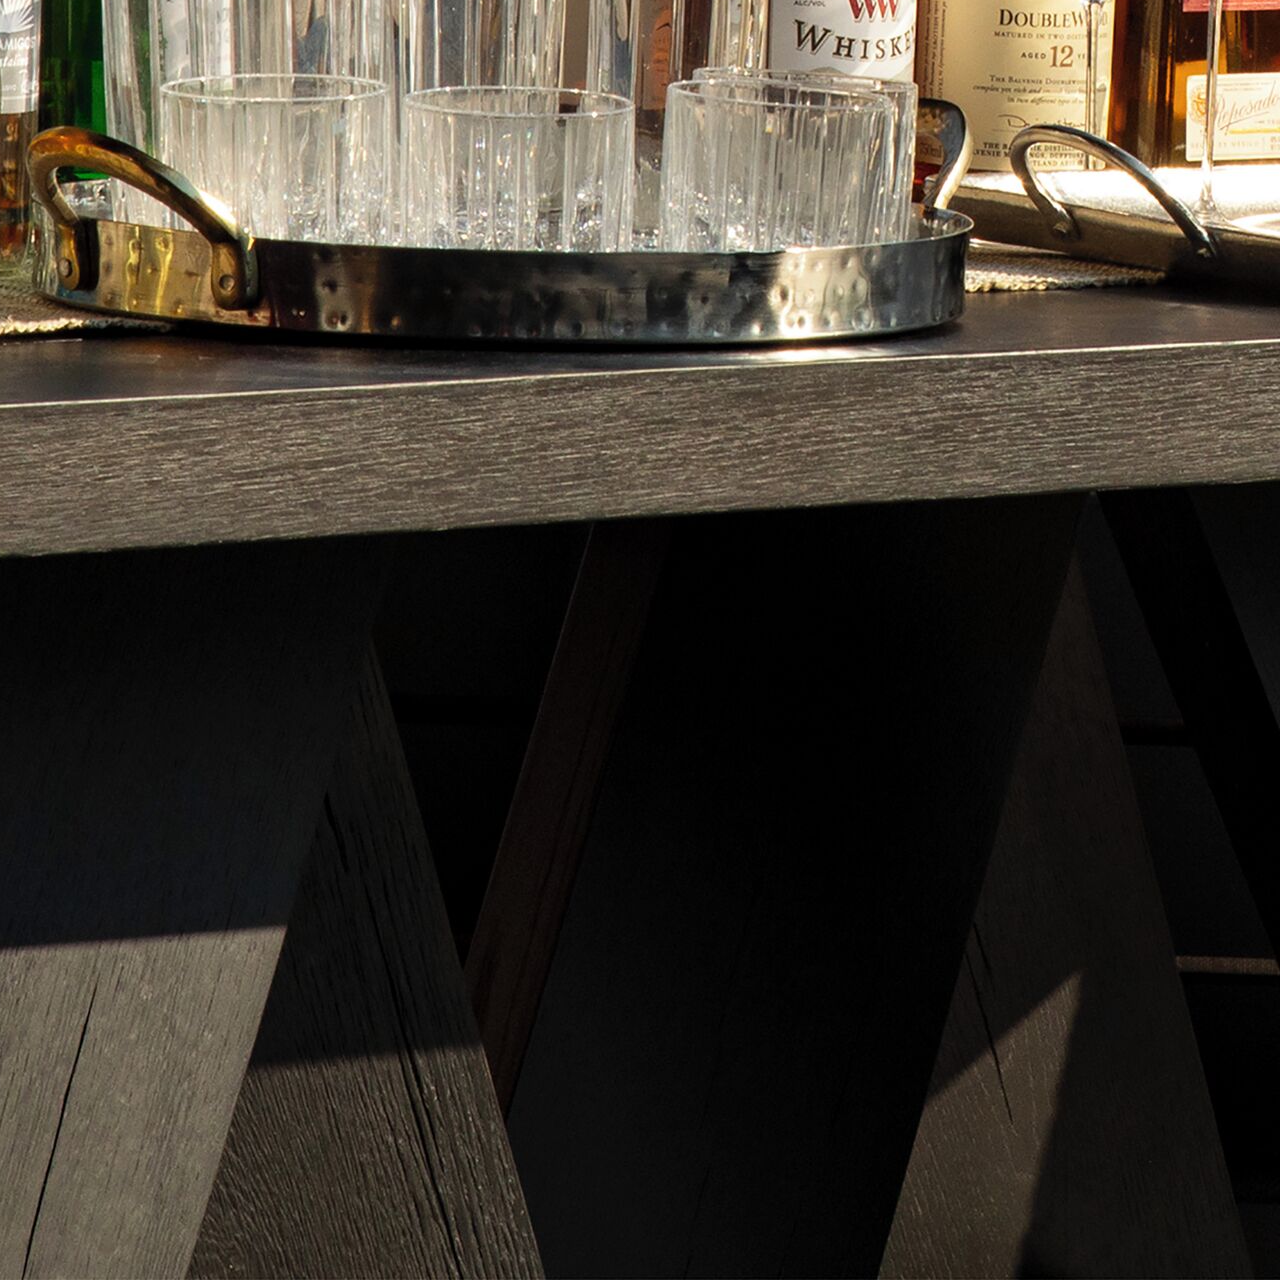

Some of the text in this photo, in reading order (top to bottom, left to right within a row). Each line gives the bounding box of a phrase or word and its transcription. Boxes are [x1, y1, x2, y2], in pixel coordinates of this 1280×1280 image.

[994, 31, 1032, 39] MATURED
[1021, 52, 1047, 60] AGED
[1049, 44, 1074, 68] 12
[1216, 80, 1280, 135] Reposado
[983, 142, 1000, 150] THE
